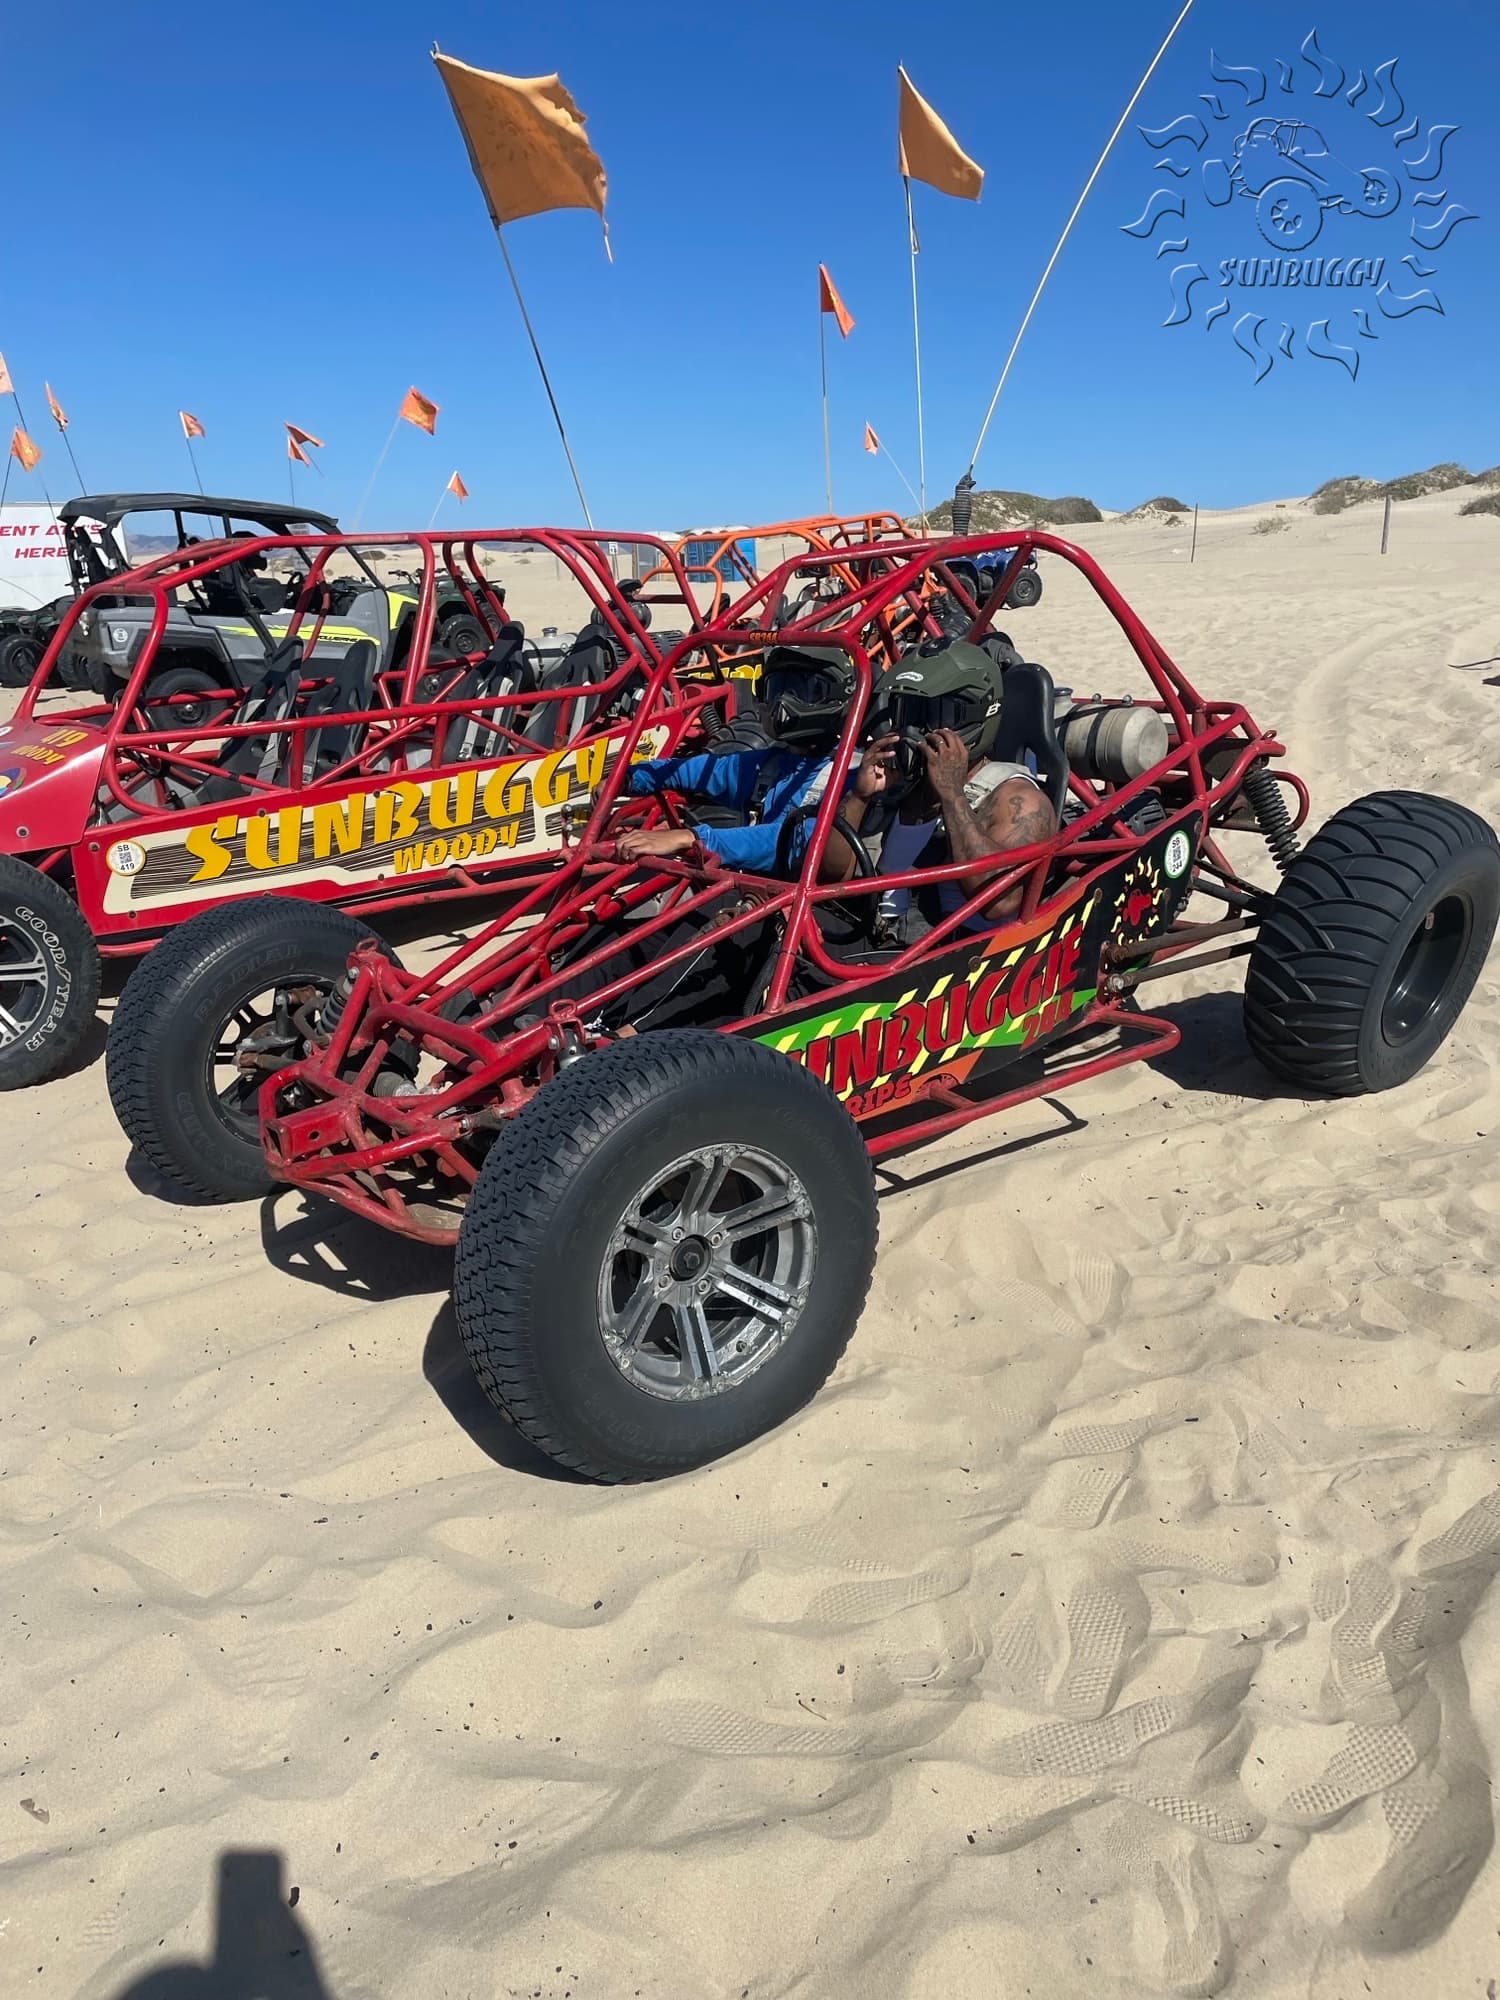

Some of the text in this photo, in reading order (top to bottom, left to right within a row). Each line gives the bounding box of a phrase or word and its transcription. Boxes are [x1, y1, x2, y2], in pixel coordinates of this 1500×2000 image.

[45, 524, 103, 536] AT'S
[14, 547, 69, 558] HERE
[185, 736, 609, 883] SUNBUGGY
[117, 844, 130, 852] SB
[393, 820, 520, 874] WOODY
[120, 862, 135, 871] 419
[844, 1071, 915, 1118] RIPE
